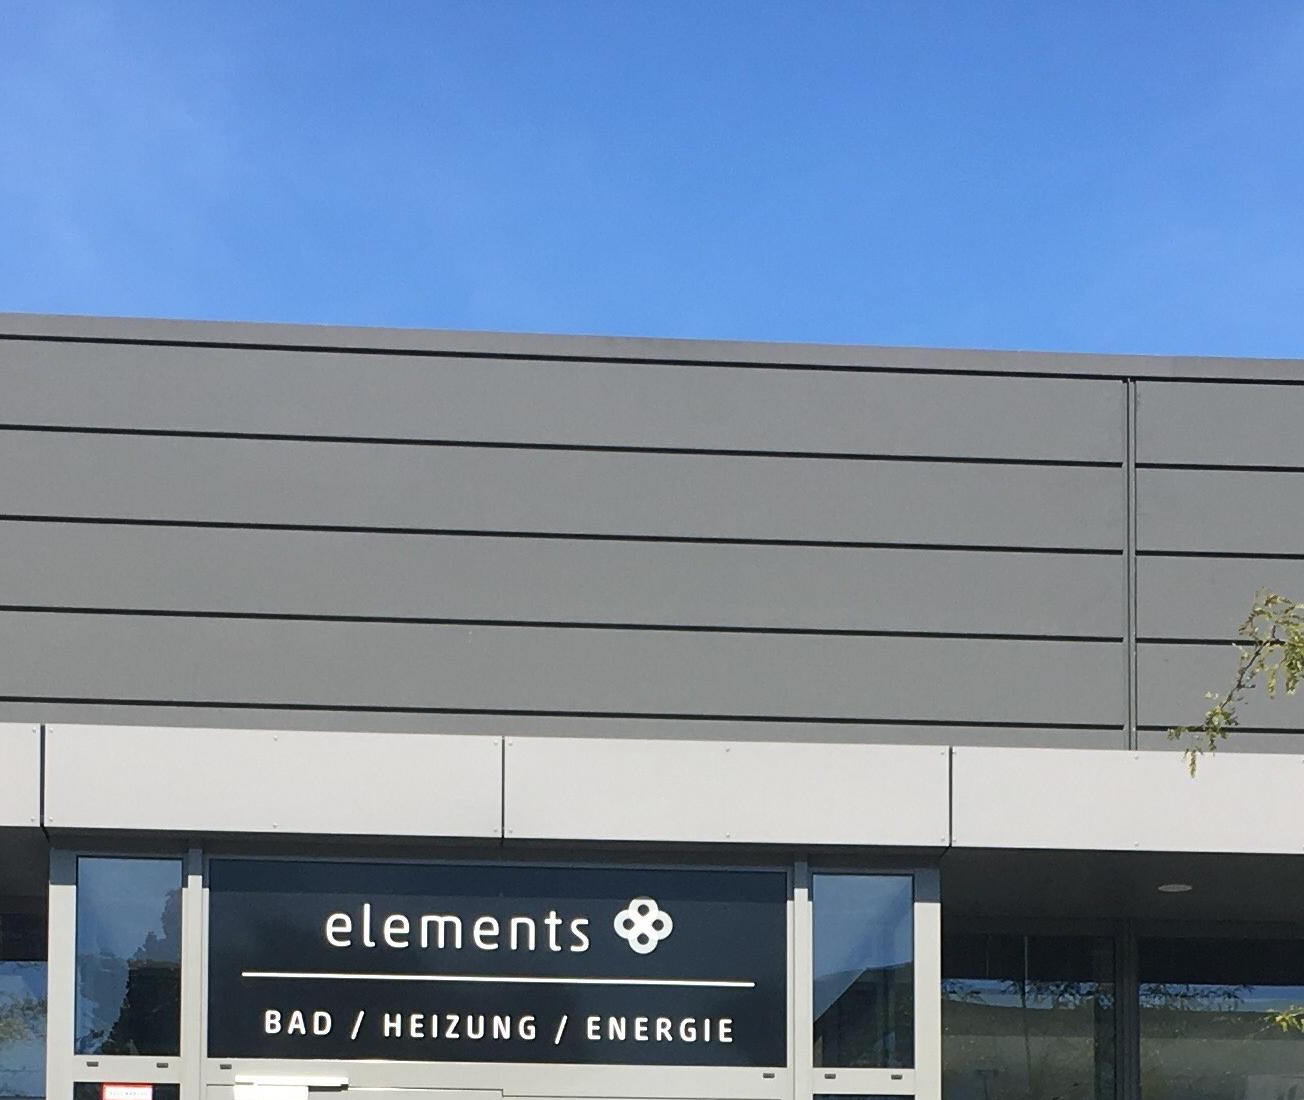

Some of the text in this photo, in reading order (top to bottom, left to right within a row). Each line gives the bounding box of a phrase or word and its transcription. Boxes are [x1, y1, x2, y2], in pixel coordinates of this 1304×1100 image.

[324, 902, 591, 953] elements
[264, 1009, 332, 1036] BAD
[383, 1012, 537, 1041] HEIZUNG
[586, 1015, 733, 1043] ENERGIE
